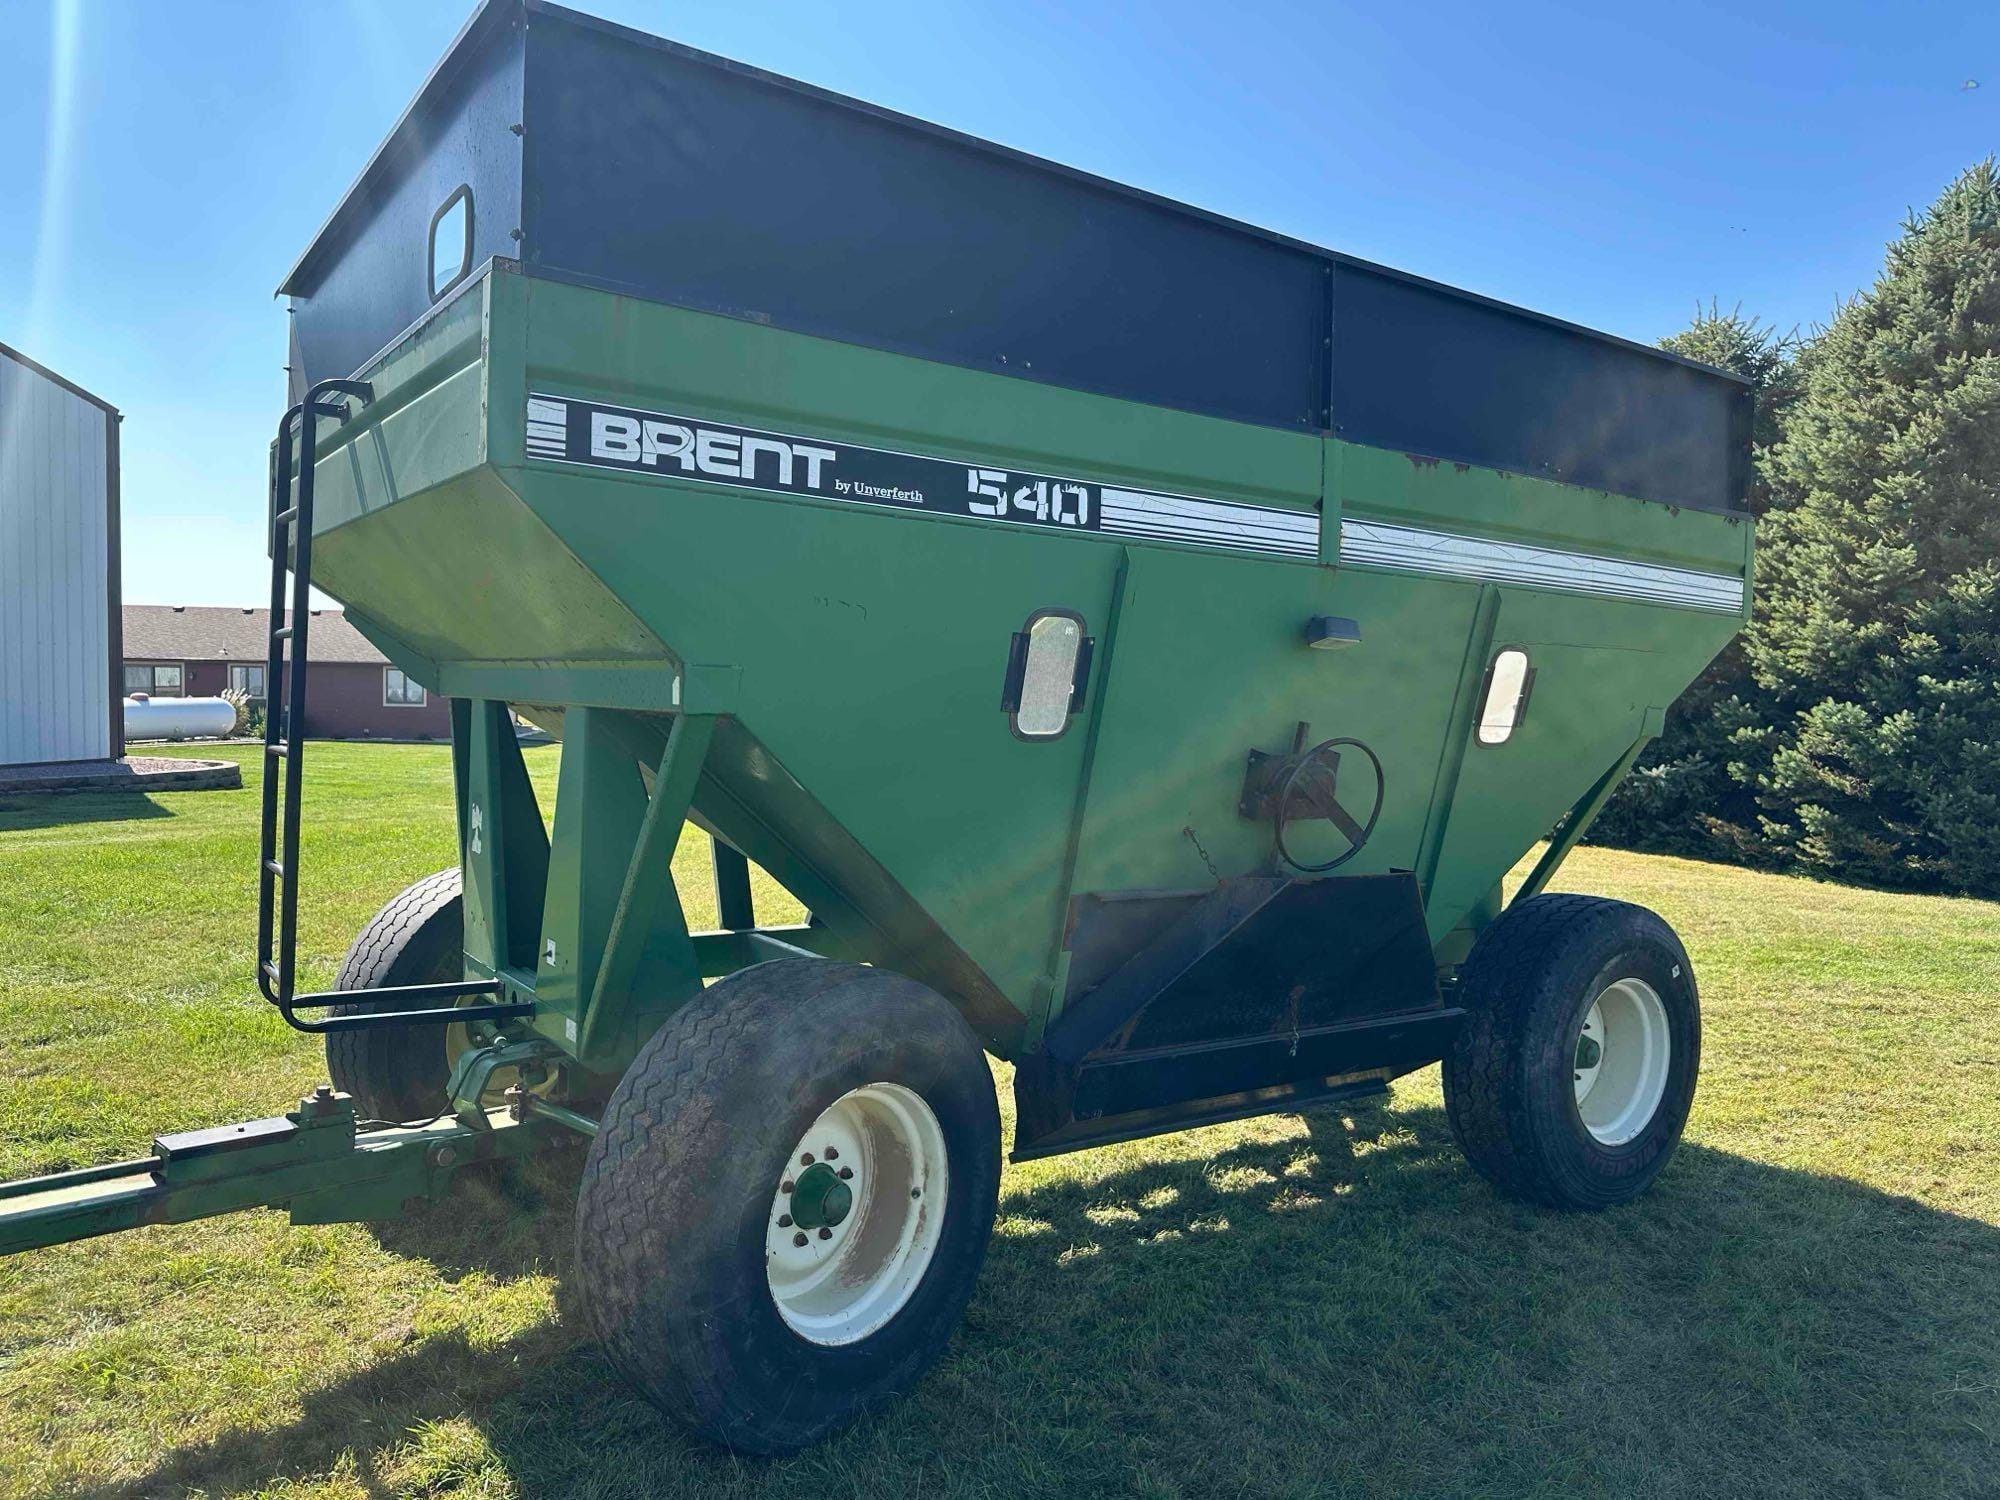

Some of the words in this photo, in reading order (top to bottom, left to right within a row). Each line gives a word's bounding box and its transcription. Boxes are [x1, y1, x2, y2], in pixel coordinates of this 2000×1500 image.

[591, 412, 836, 489] BRENT
[834, 479, 851, 494] by
[854, 481, 924, 503] Unverferth
[967, 468, 1088, 525] 540
